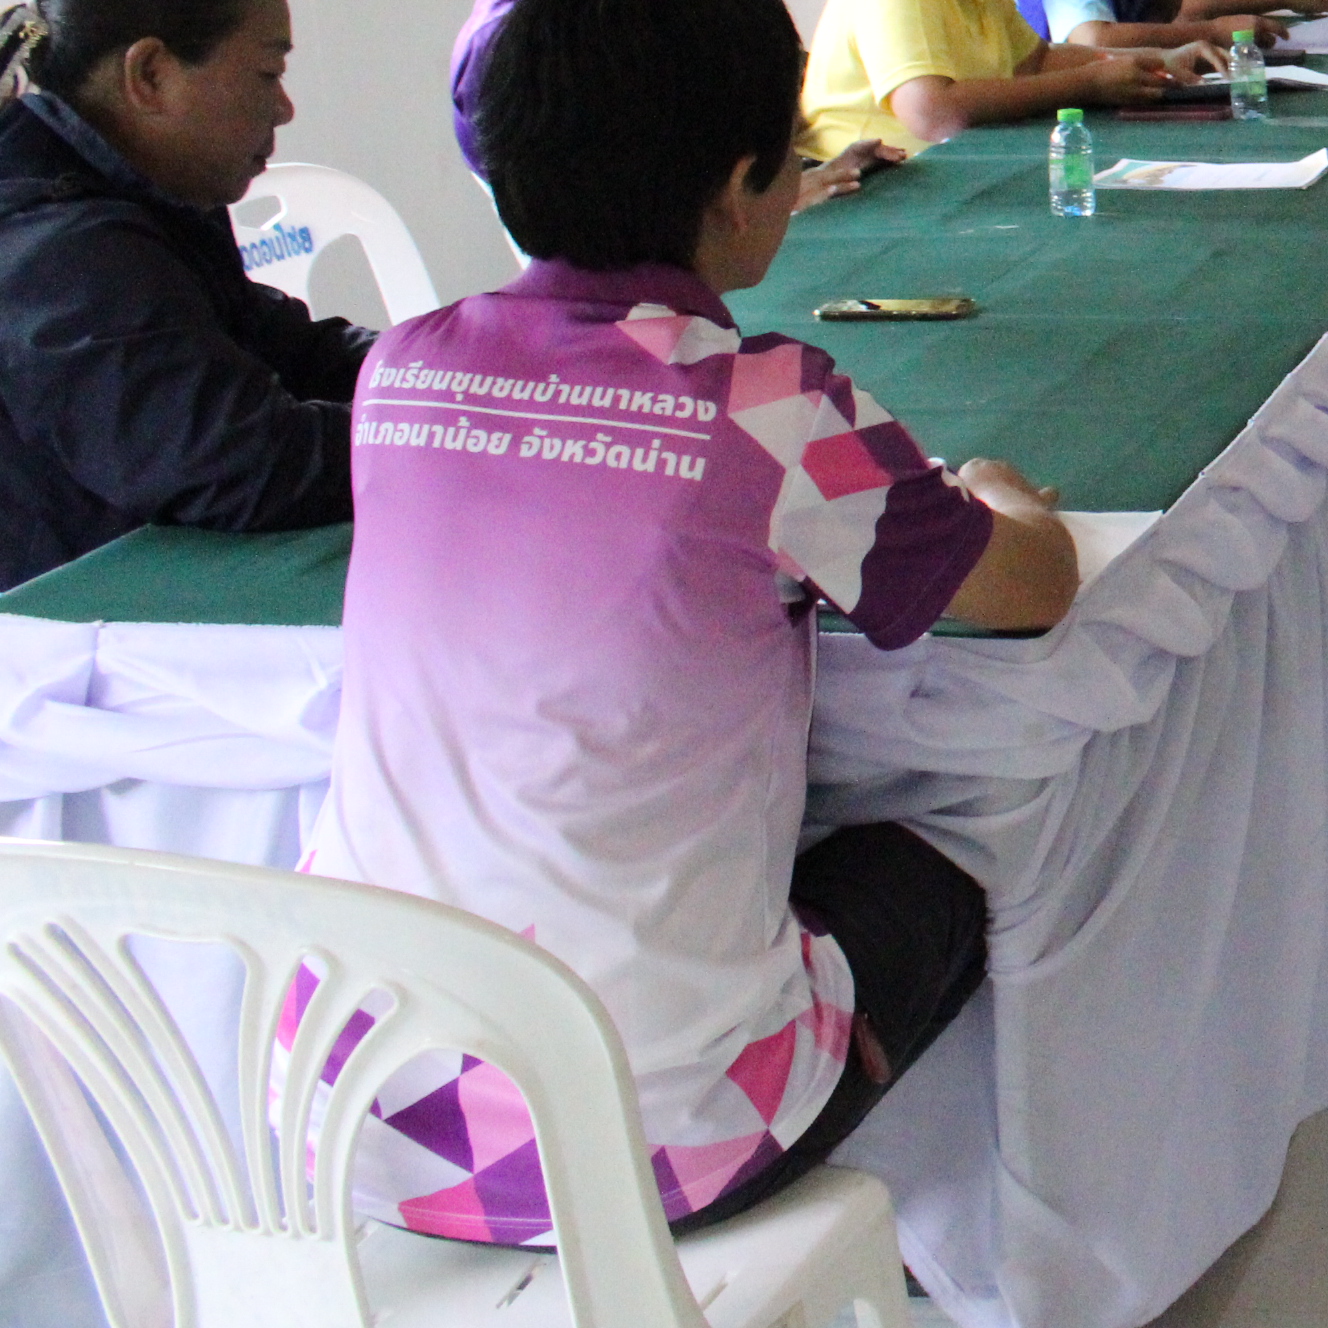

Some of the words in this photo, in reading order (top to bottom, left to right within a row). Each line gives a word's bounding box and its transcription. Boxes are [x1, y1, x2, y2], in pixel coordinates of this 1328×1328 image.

[518, 427, 706, 481] จังหวัดน่าน
